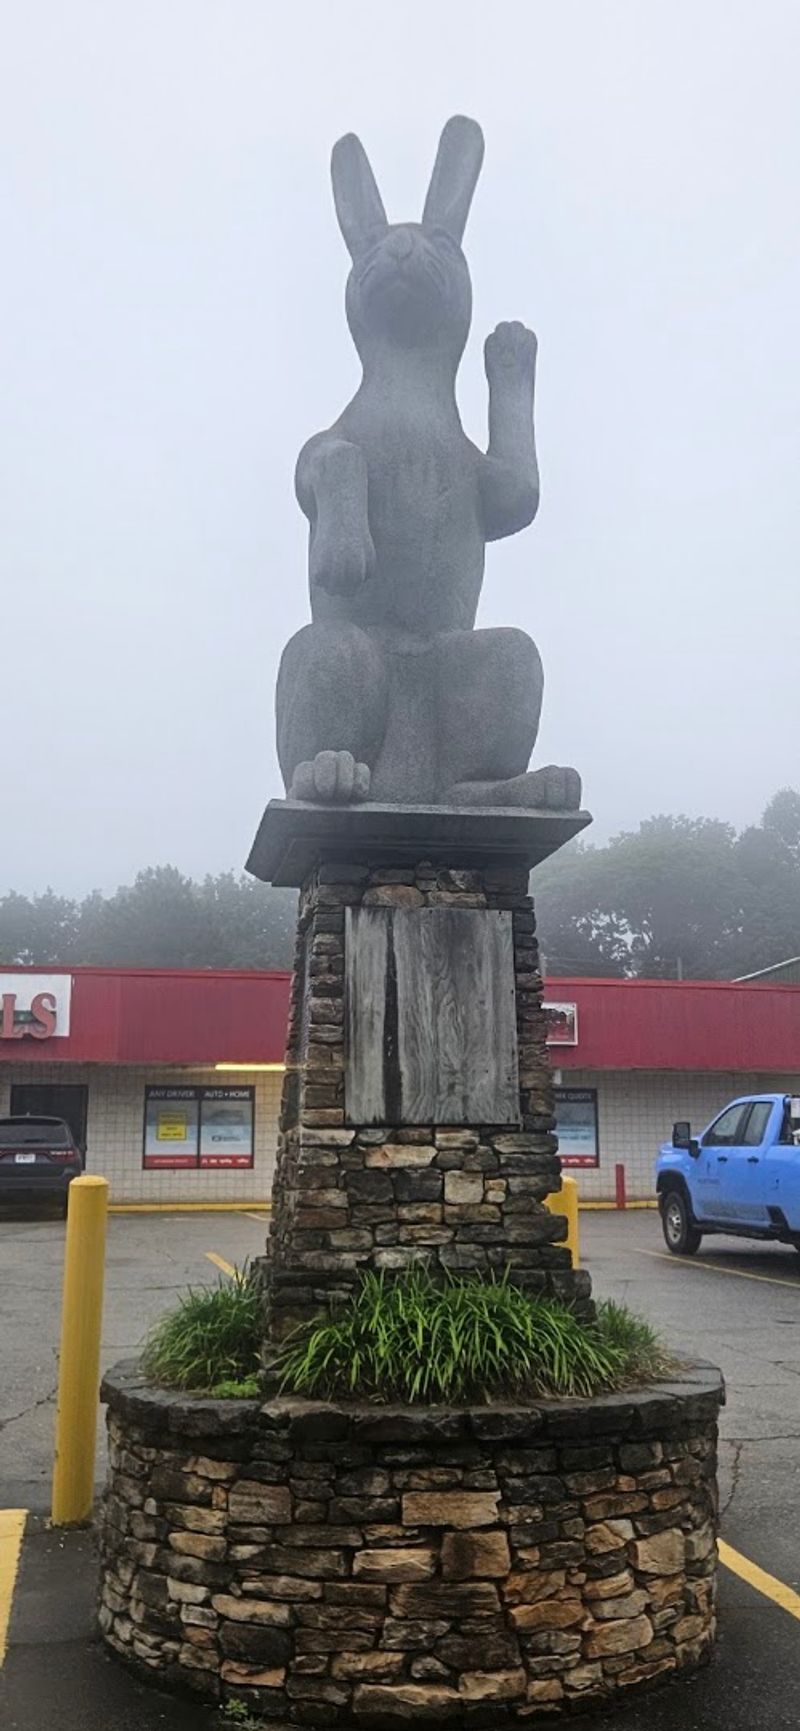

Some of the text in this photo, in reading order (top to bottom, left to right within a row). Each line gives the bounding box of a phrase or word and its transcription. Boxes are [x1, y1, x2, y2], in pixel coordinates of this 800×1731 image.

[149, 1089, 195, 1098] ANY DRIVER
[204, 1089, 250, 1098] AUTO HOME
